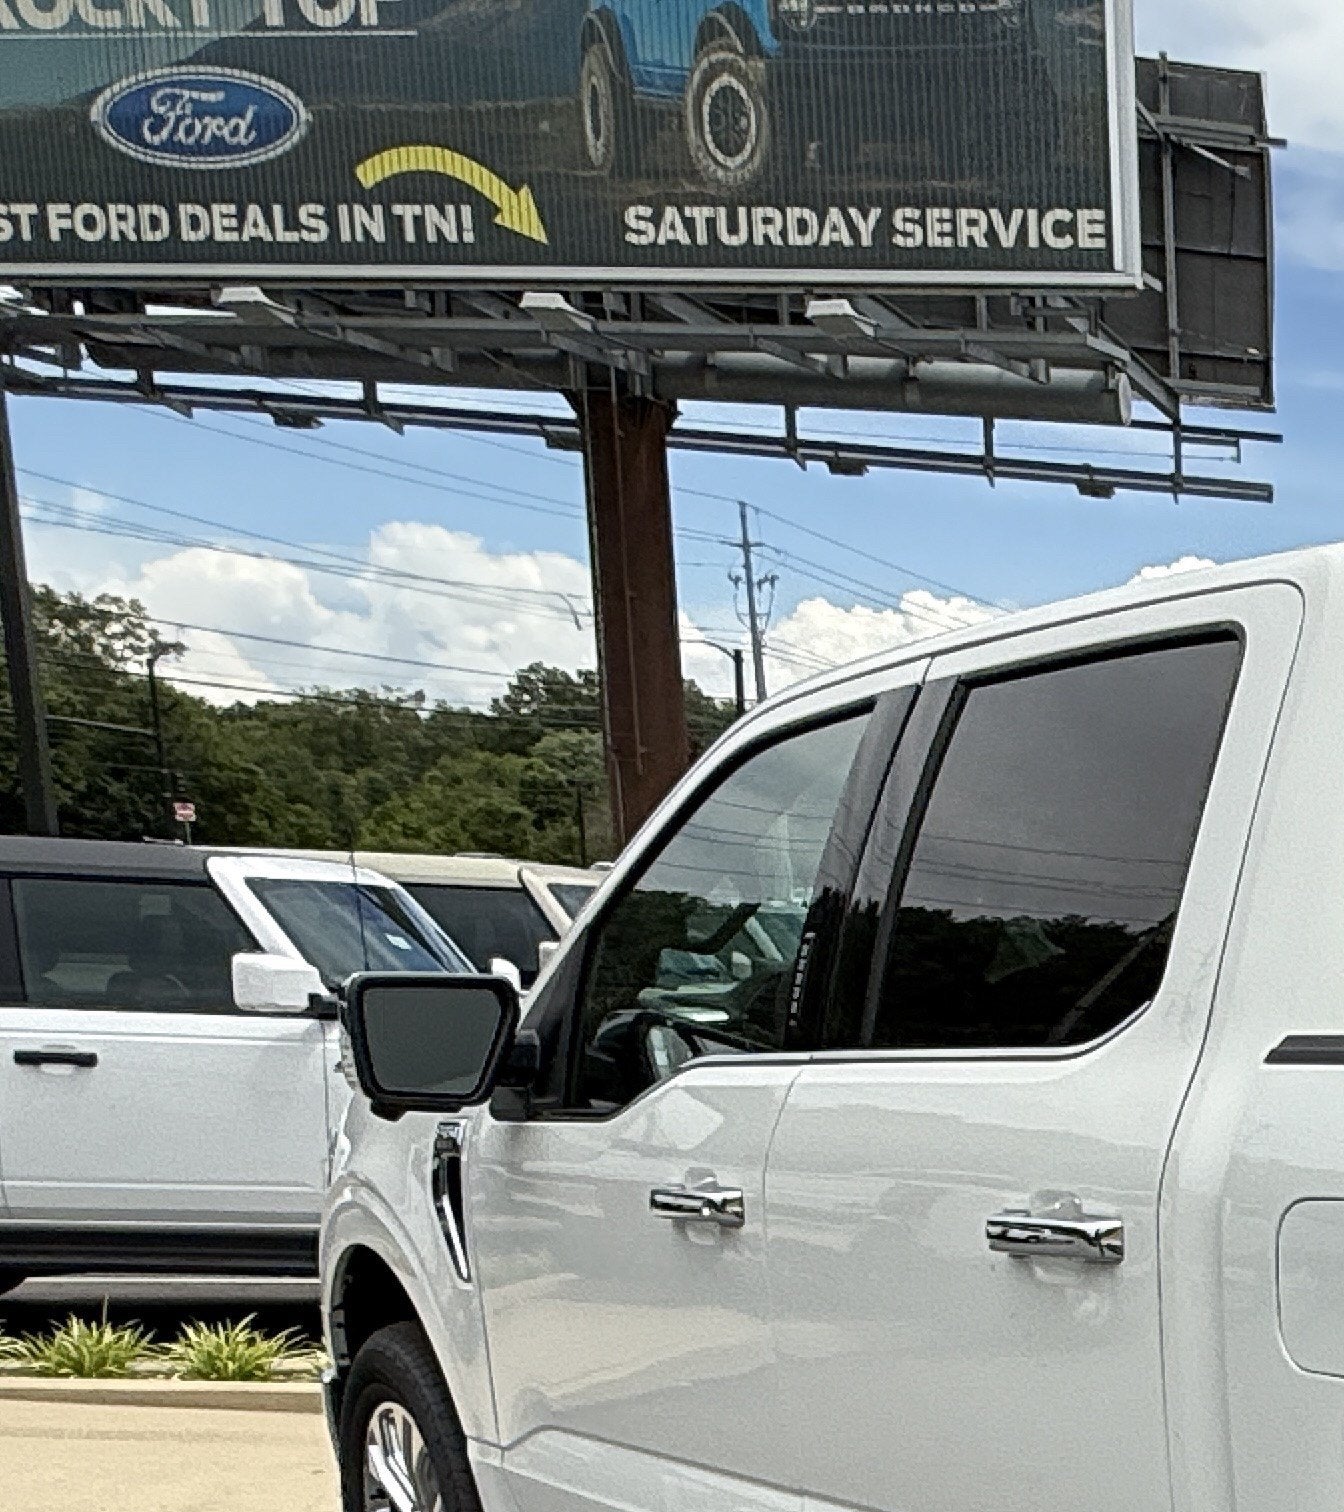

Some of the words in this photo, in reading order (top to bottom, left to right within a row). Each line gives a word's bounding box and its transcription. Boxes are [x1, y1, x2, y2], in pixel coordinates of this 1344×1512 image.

[142, 87, 257, 145] Ford
[46, 203, 170, 243] FORD
[179, 204, 328, 243] DEALS
[339, 204, 386, 244] IN
[392, 204, 476, 244] TN!
[624, 205, 882, 248] SATURDAY
[892, 207, 1107, 249] SERVICE
